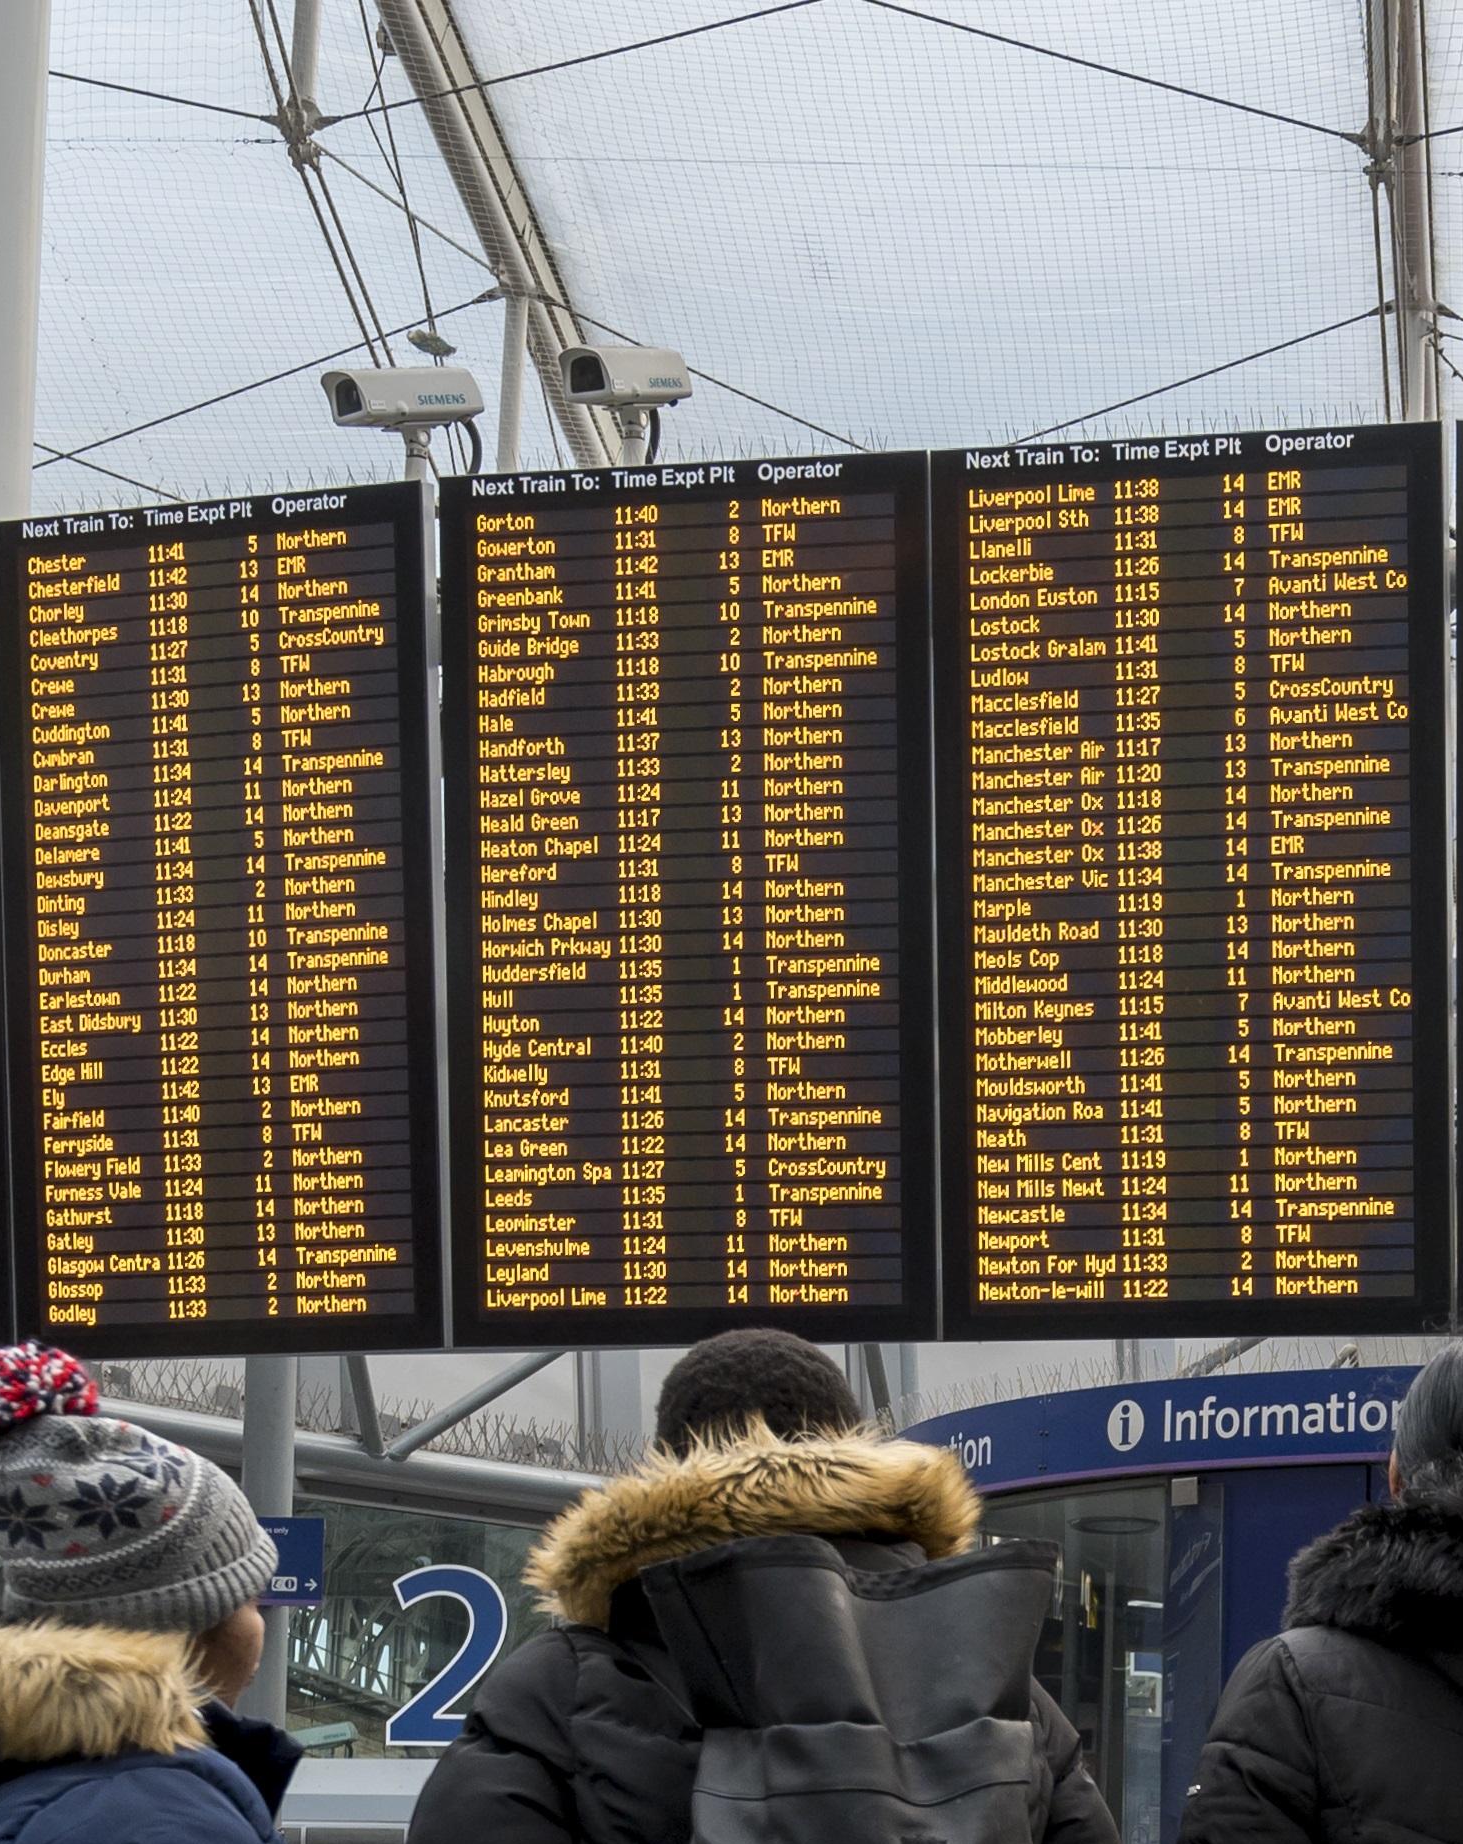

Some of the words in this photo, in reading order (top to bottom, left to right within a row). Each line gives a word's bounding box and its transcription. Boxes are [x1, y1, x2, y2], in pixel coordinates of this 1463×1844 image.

[476, 536, 556, 558] Gowerton
[614, 529, 657, 551] 11:31
[728, 525, 740, 545] 8
[761, 522, 796, 543] TFW
[28, 572, 121, 600] Chesterfield
[148, 566, 188, 588] 11:42
[239, 559, 259, 580] 13
[276, 554, 307, 576] EMR
[969, 562, 1055, 586] Lockerbie
[1114, 555, 1160, 578] 11:26
[1223, 551, 1245, 572] 14
[1267, 544, 1389, 572] Transpennine
[387, 1564, 507, 1746] 2
